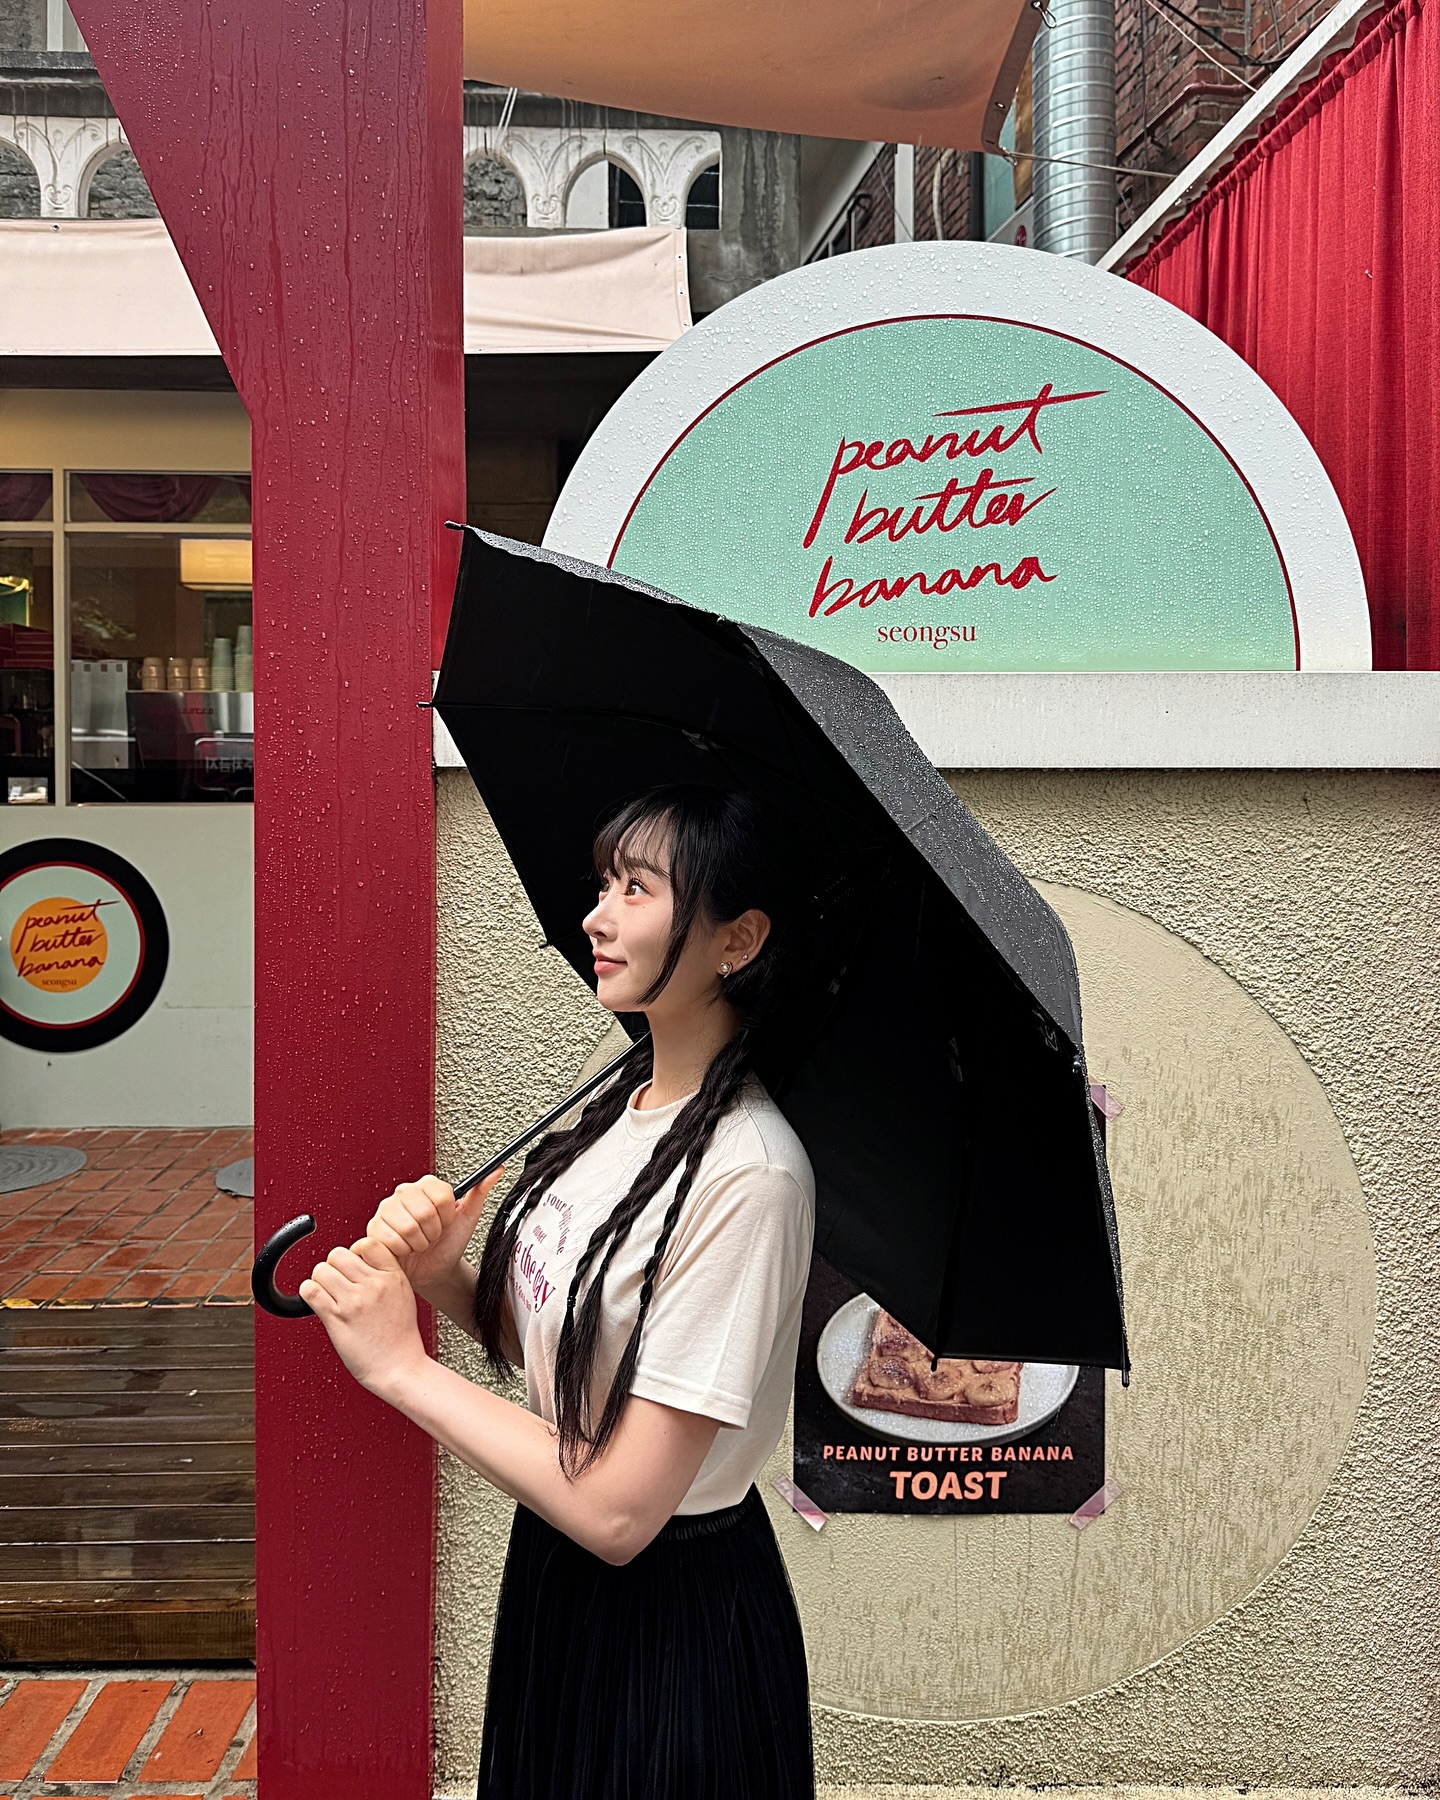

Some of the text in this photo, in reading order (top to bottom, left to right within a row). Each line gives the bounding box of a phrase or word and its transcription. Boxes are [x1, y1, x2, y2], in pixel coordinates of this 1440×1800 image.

[803, 383, 1109, 549] peanut
[844, 468, 1058, 544] butter
[809, 556, 1058, 618] banana
[877, 624, 977, 650] seongsu
[15, 899, 120, 954] peanut
[30, 927, 104, 952] butter
[18, 956, 104, 977] banana
[543, 1193, 567, 1212] your
[520, 1244, 556, 1313] the day
[823, 1445, 1074, 1462] PEANUT BUTTER BANANA
[889, 1471, 1008, 1500] TOAST
